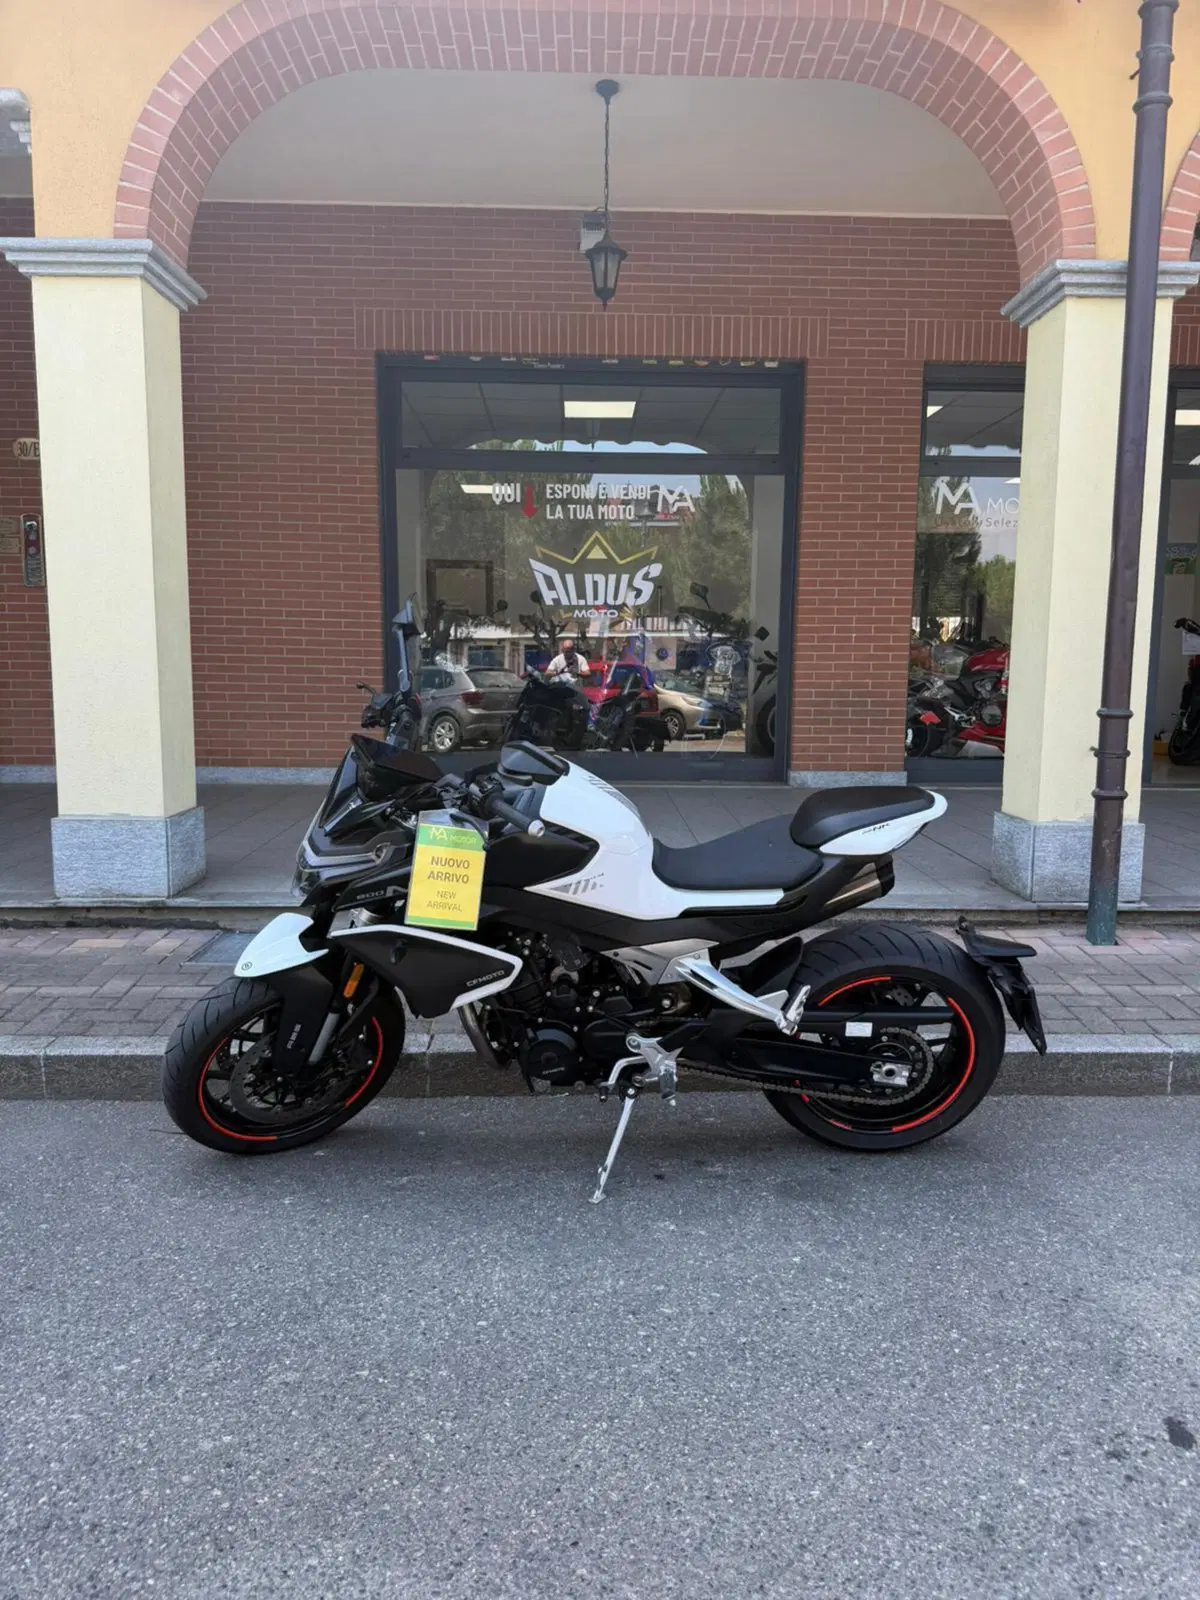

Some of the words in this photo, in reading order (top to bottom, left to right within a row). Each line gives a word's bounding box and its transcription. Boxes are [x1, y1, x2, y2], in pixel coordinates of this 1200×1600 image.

[491, 482, 521, 504] QUI
[546, 483, 594, 500] ESPONI
[611, 484, 651, 500] VENDI
[546, 504, 564, 520] LA
[568, 504, 594, 520] TUA
[598, 504, 635, 520] MOTO
[528, 558, 663, 606] ALDUS
[572, 609, 619, 618] MOTO
[430, 855, 471, 870] NUOVO
[427, 870, 470, 885] ARRIVO
[436, 890, 457, 900] NEW
[426, 900, 463, 912] ARRIVAL
